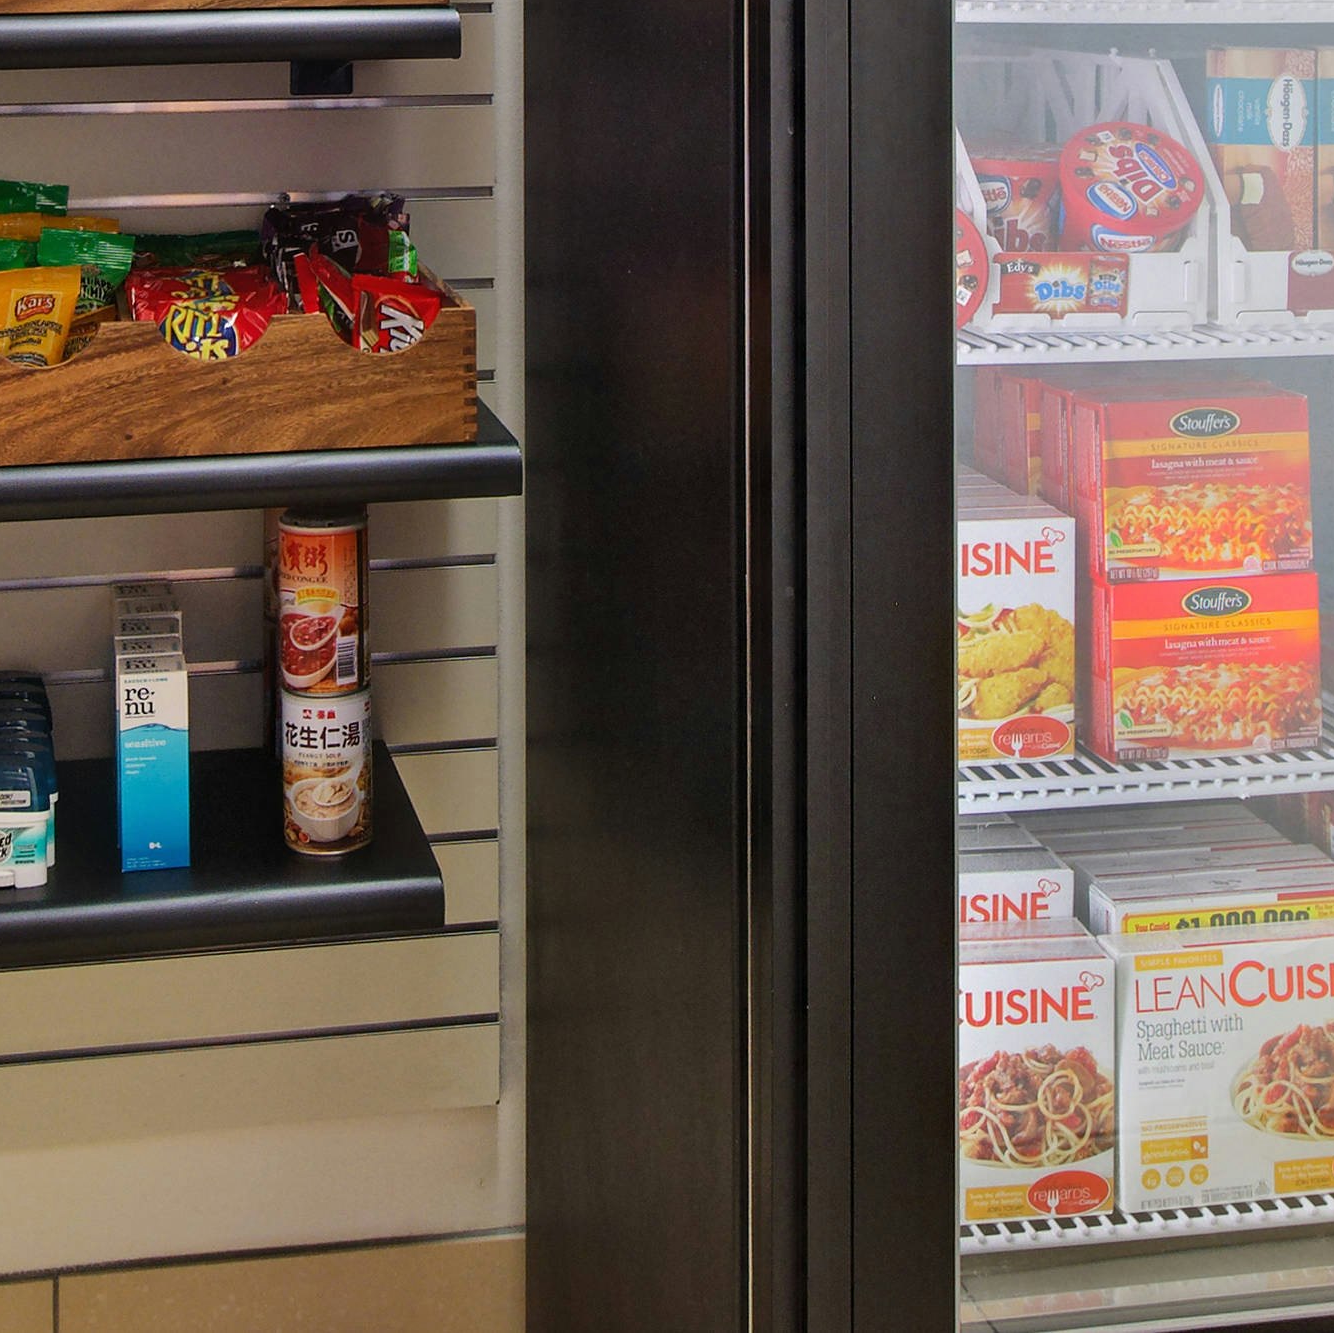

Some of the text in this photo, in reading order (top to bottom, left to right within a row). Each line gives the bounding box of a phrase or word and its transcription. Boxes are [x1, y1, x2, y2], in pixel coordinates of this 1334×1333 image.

[1281, 77, 1294, 148] Häagen-Dazs
[1108, 144, 1163, 203] Dibs
[1007, 259, 1034, 273] Edy's
[1034, 281, 1086, 301] Dibs
[1094, 280, 1120, 292] Dibs
[15, 295, 55, 318] Kar's
[1178, 415, 1233, 435] Stouffer's
[1151, 439, 1260, 452] SIGNATURE CLASSICS
[1151, 456, 1259, 470] lasagna with meat sauce
[1190, 593, 1243, 613] Stouffer's
[1163, 618, 1272, 632] SIGNATURE CLASSICS
[1164, 636, 1272, 651] lasagna with meat sauce
[125, 702, 155, 716] nu
[125, 738, 166, 748] sensitive
[285, 722, 361, 749] 花生仁湯
[1135, 973, 1226, 1013] LEAN
[1136, 1013, 1244, 1040] Spaghetti with
[1138, 1042, 1175, 1061] Meat
